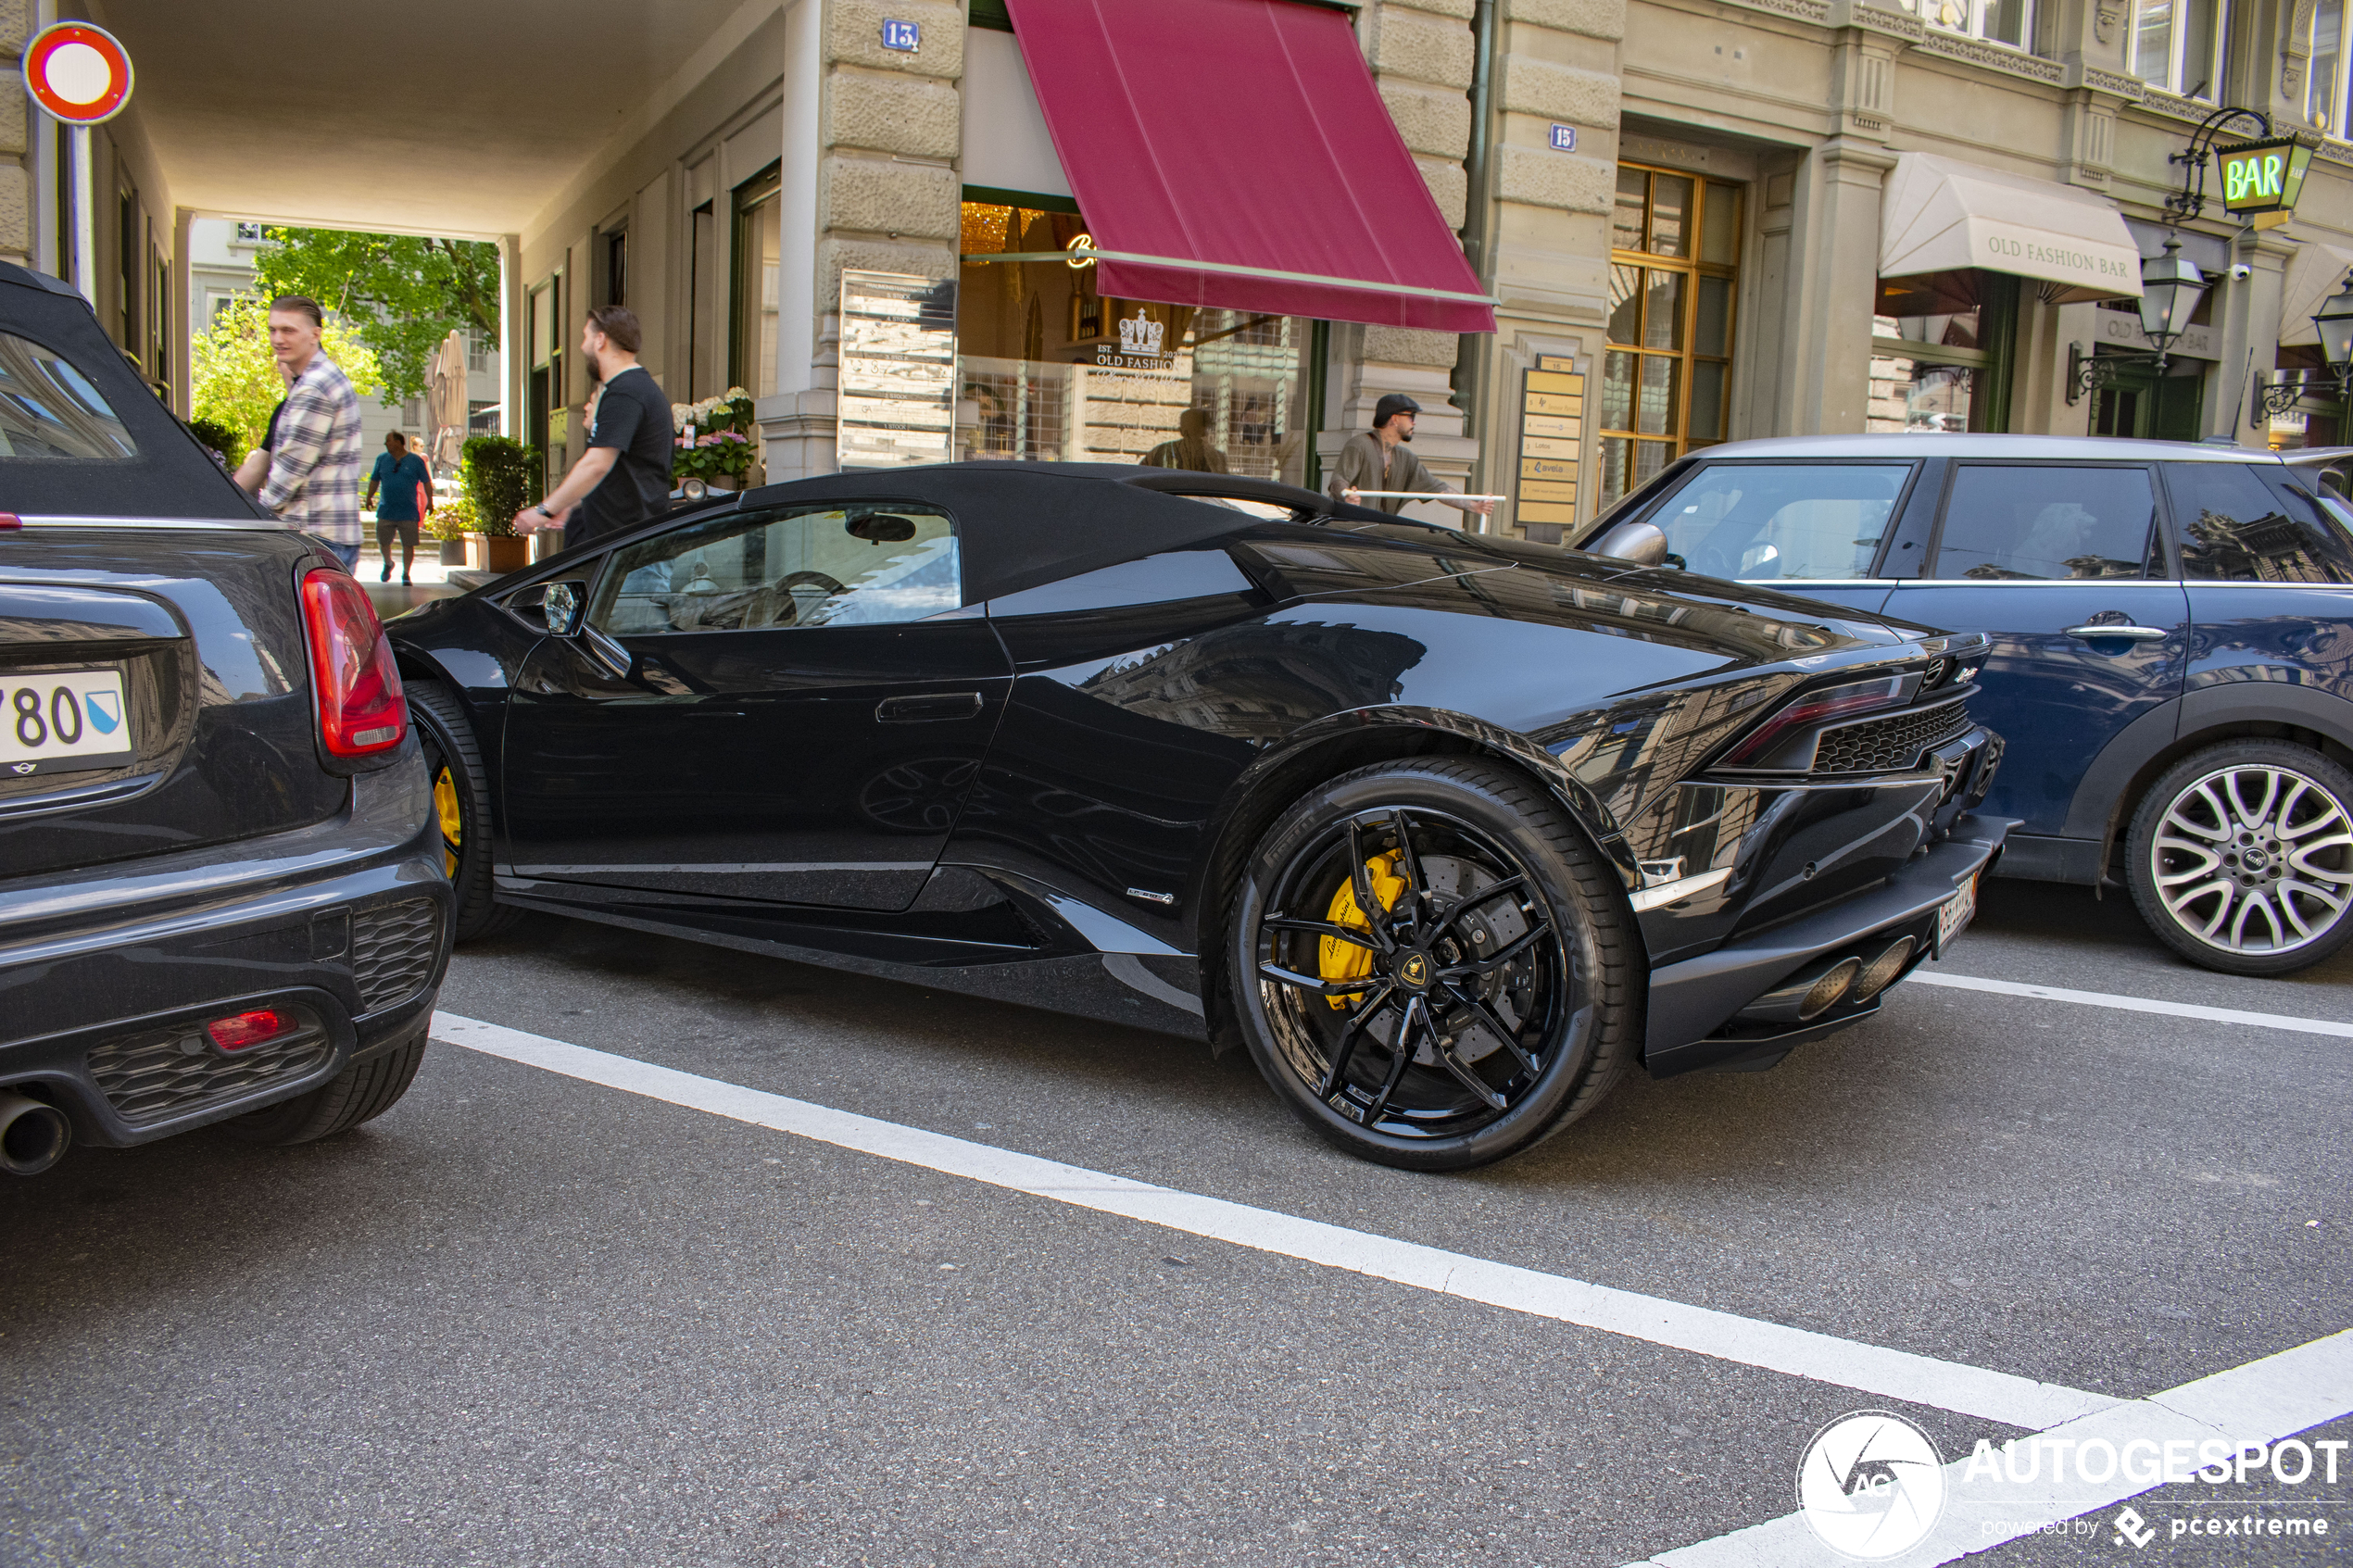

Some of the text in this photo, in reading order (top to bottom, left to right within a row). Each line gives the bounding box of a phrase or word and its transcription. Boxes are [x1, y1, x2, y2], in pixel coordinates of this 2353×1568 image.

[888, 22, 913, 46] 13
[1556, 128, 1571, 147] 15
[2226, 155, 2282, 201] BAR
[2289, 167, 2304, 180] BAR
[1989, 237, 2128, 278] OLD FASHION BAR
[1098, 345, 1112, 353] EST.
[1097, 355, 1182, 372] OLD FASHION
[1542, 464, 1564, 473] avela
[0, 685, 82, 747] 80
[2246, 853, 2263, 867] MINI
